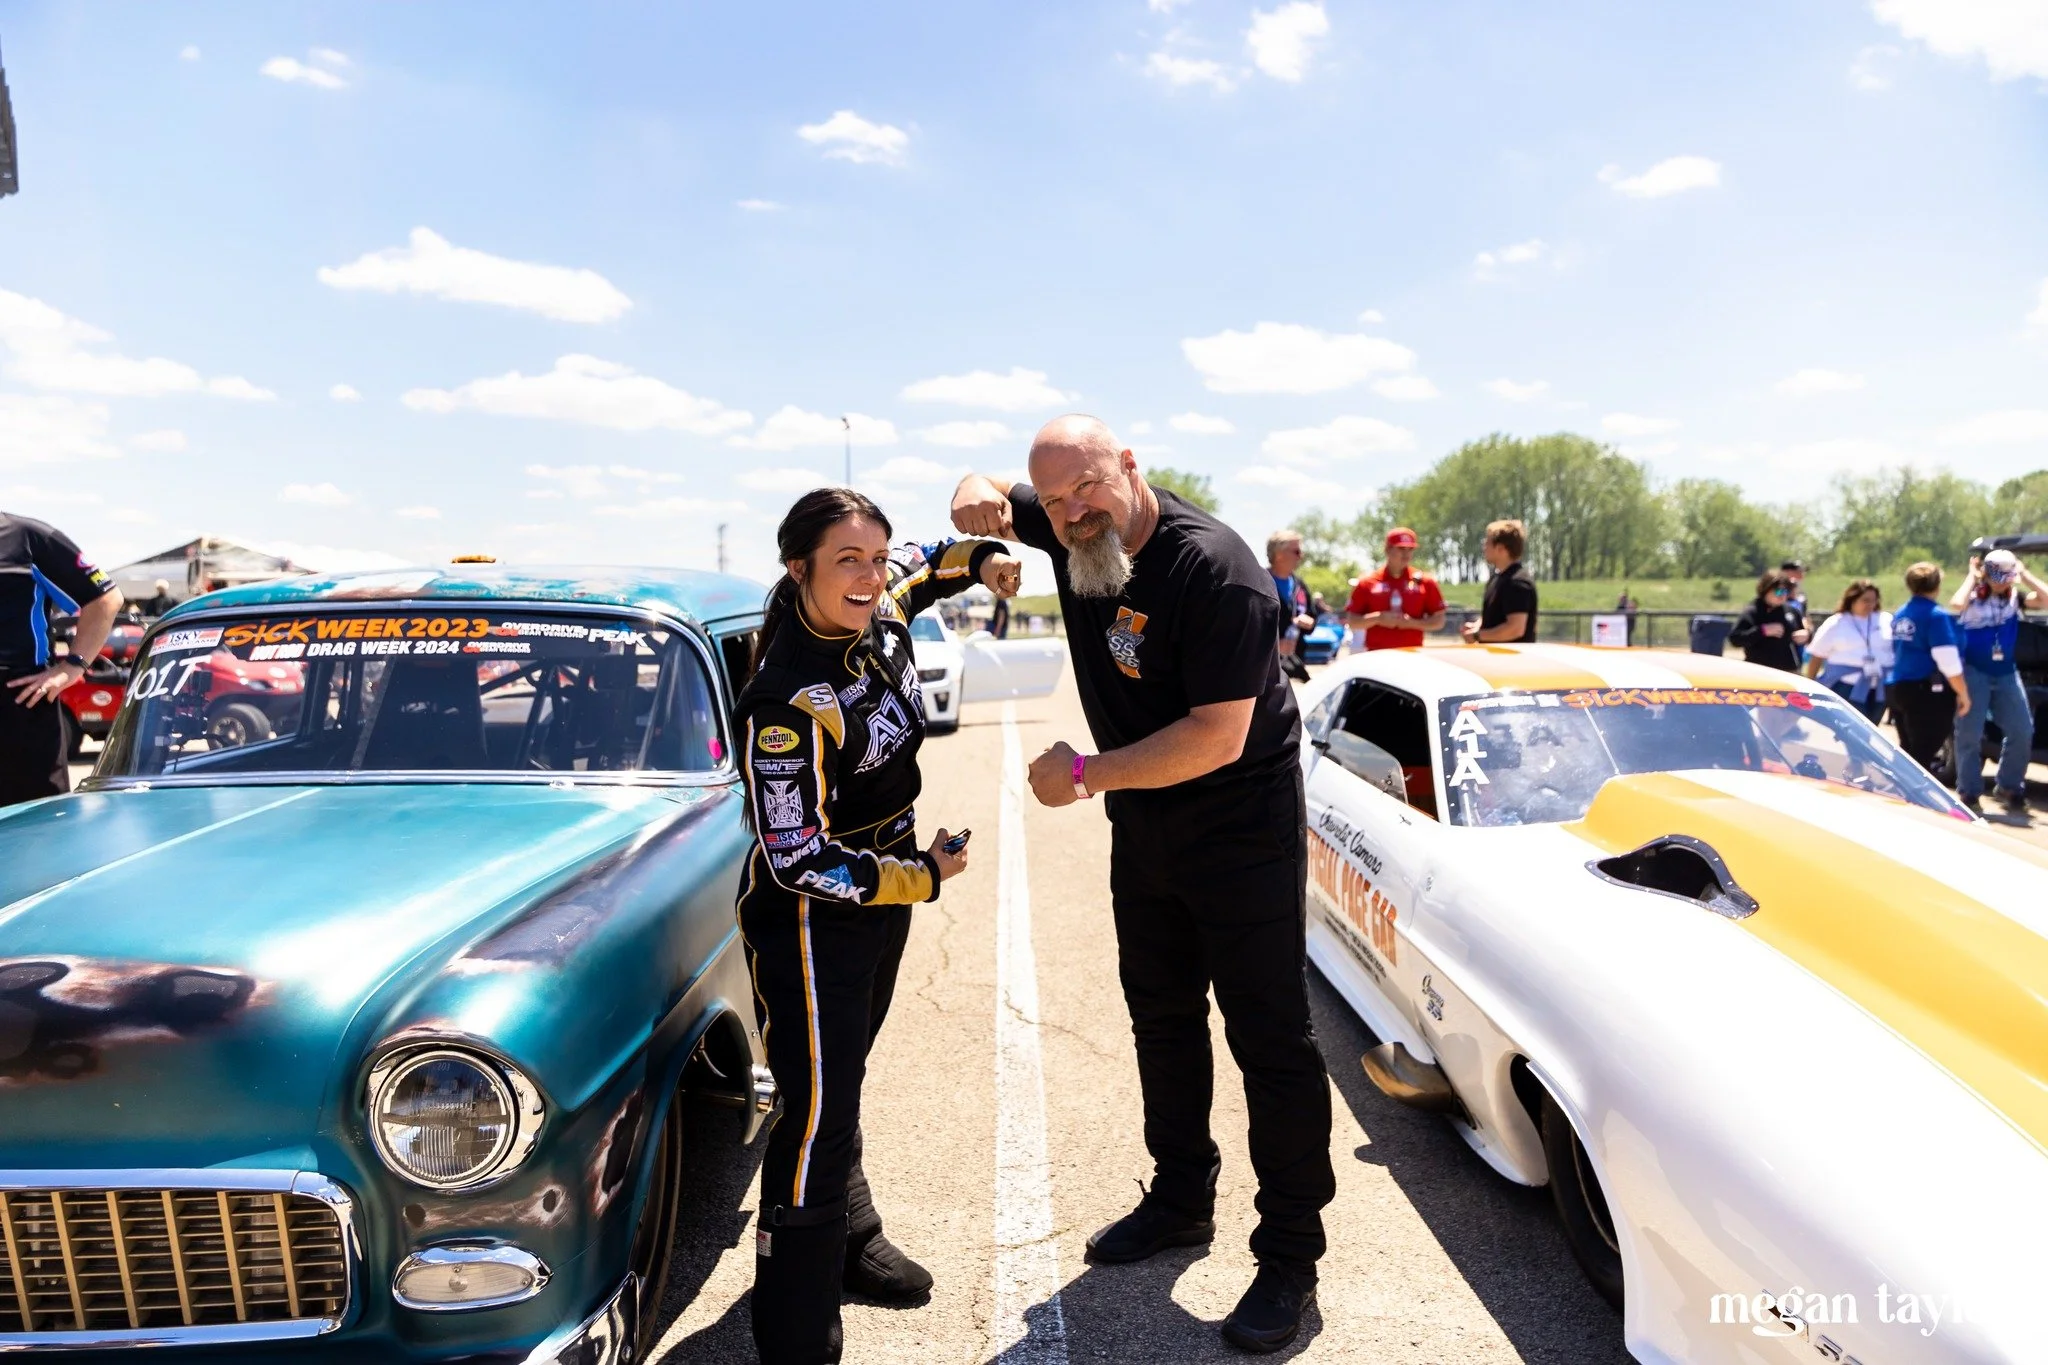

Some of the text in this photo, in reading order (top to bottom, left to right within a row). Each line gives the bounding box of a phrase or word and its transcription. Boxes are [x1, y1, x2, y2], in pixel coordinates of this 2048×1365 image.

[224, 617, 317, 646] SICK
[317, 618, 405, 639] WEEK
[407, 618, 489, 638] 2023
[589, 628, 647, 647] PEAK
[307, 642, 356, 657] DRAG
[360, 641, 412, 656] WEEK
[413, 641, 459, 655] 2024
[760, 732, 794, 745] PENNZOIL
[776, 830, 802, 842] ISKY
[772, 835, 822, 869] Holley
[795, 870, 867, 904] PEAK
